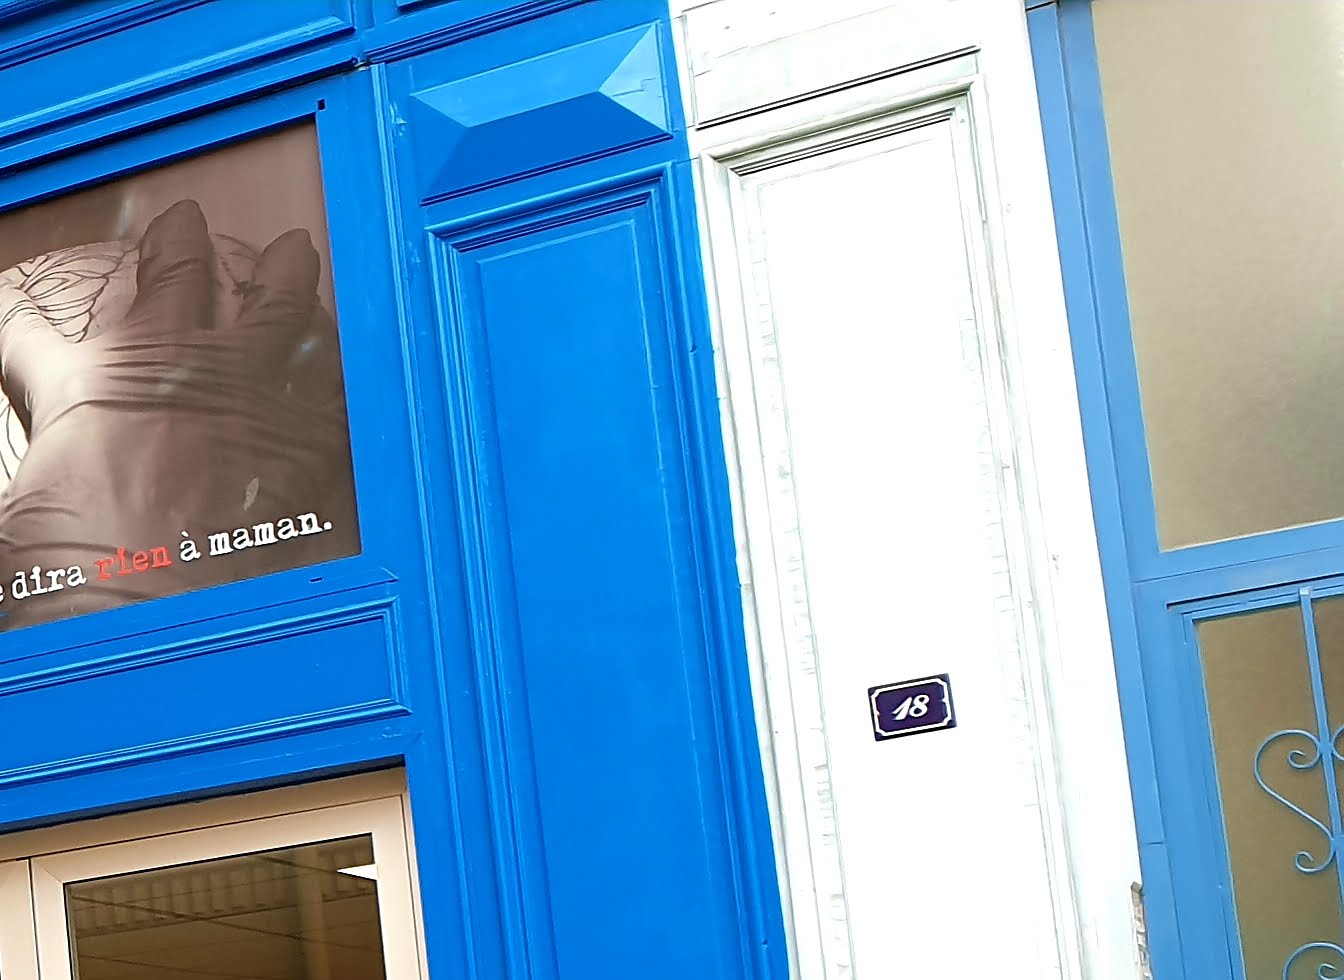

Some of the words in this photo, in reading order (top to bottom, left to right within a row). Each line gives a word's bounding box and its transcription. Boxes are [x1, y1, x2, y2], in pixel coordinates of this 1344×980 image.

[11, 563, 87, 601] dira
[94, 545, 171, 582] rien
[179, 531, 201, 562] à
[208, 511, 334, 557] maman.
[892, 694, 930, 721] 18
